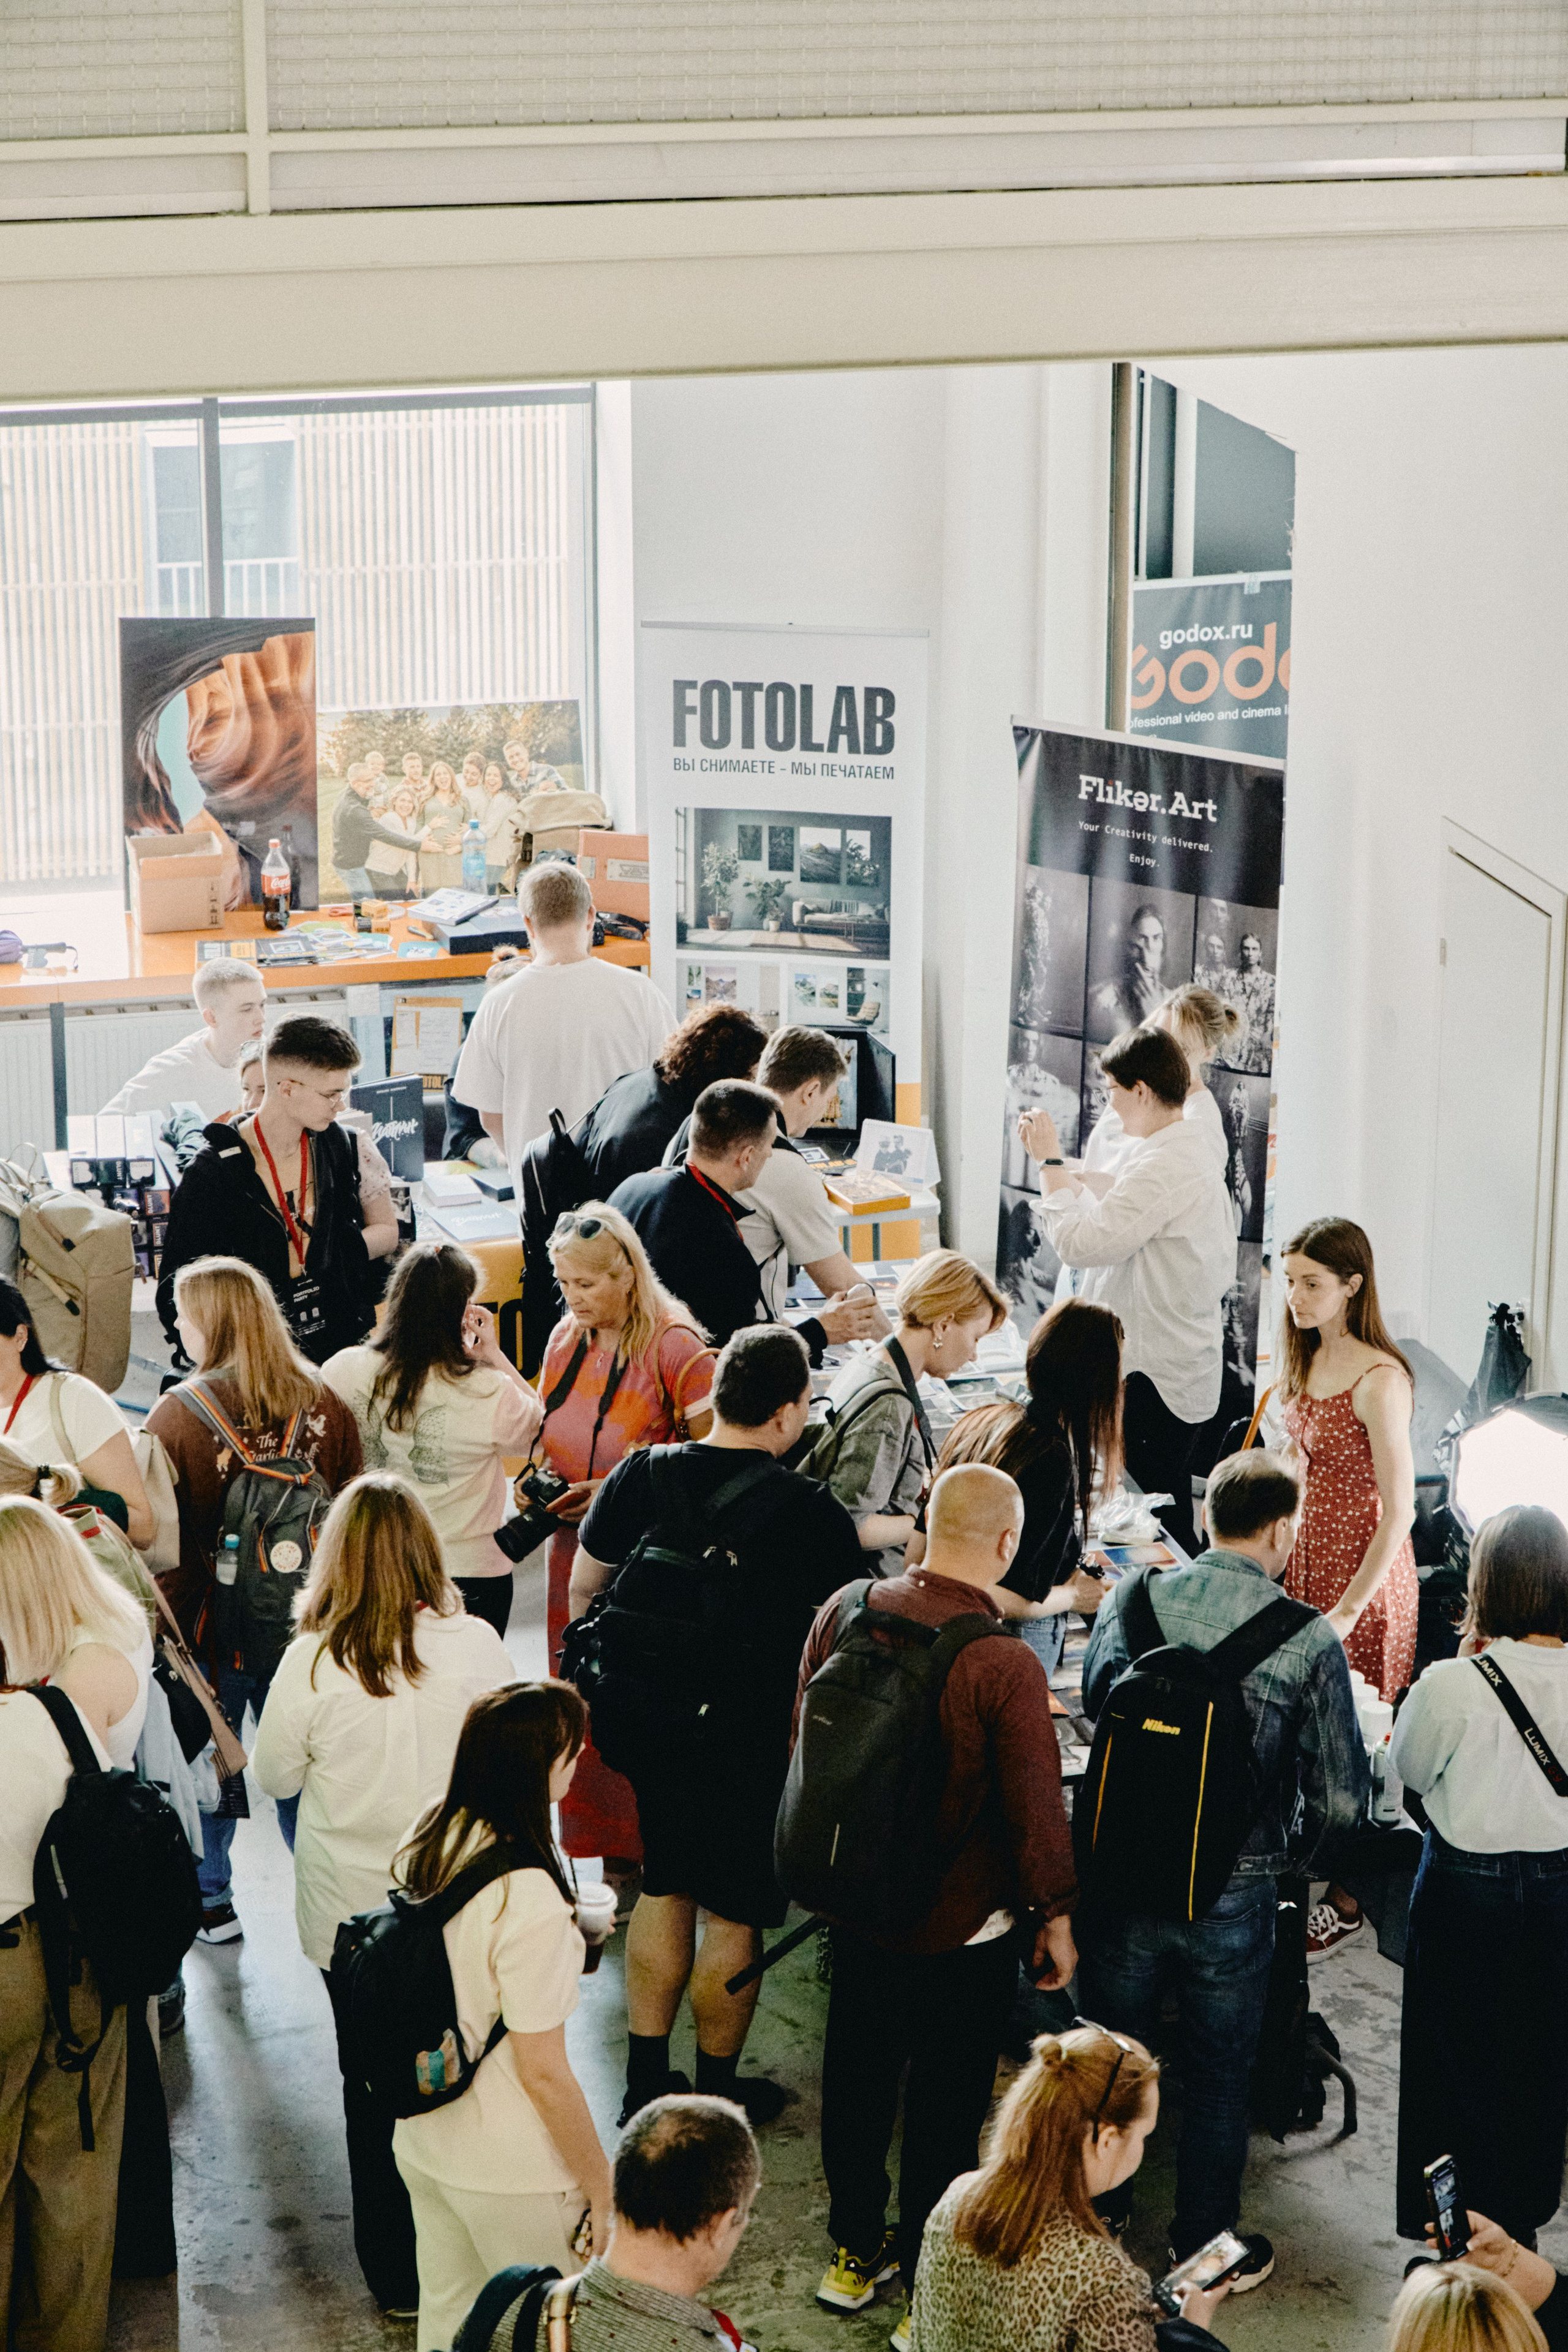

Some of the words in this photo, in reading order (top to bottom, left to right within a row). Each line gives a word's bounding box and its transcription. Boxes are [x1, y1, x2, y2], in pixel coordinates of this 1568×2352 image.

[1159, 624, 1253, 649] godox.ru
[1131, 622, 1291, 710] God
[673, 679, 895, 756] FOTOLAB
[1184, 710, 1215, 723] video
[1217, 708, 1238, 720] and
[1242, 707, 1281, 719] cinema
[673, 758, 695, 771] ВЫ
[700, 758, 775, 774] СНИМАЕТЕ
[791, 761, 816, 775] МЫ
[821, 763, 895, 780] ПЕЧАТАЕМ
[1079, 821, 1099, 832] Your
[1104, 825, 1157, 843] Creativity
[1162, 836, 1213, 853] delivered.
[1129, 854, 1160, 867] Enjoy.
[293, 1286, 320, 1298] PORTFOLIO
[293, 1294, 308, 1303] PARTY
[256, 1431, 279, 1449] The
[1142, 1718, 1181, 1735] Nikon
[1524, 1727, 1551, 1766] LUMIX
